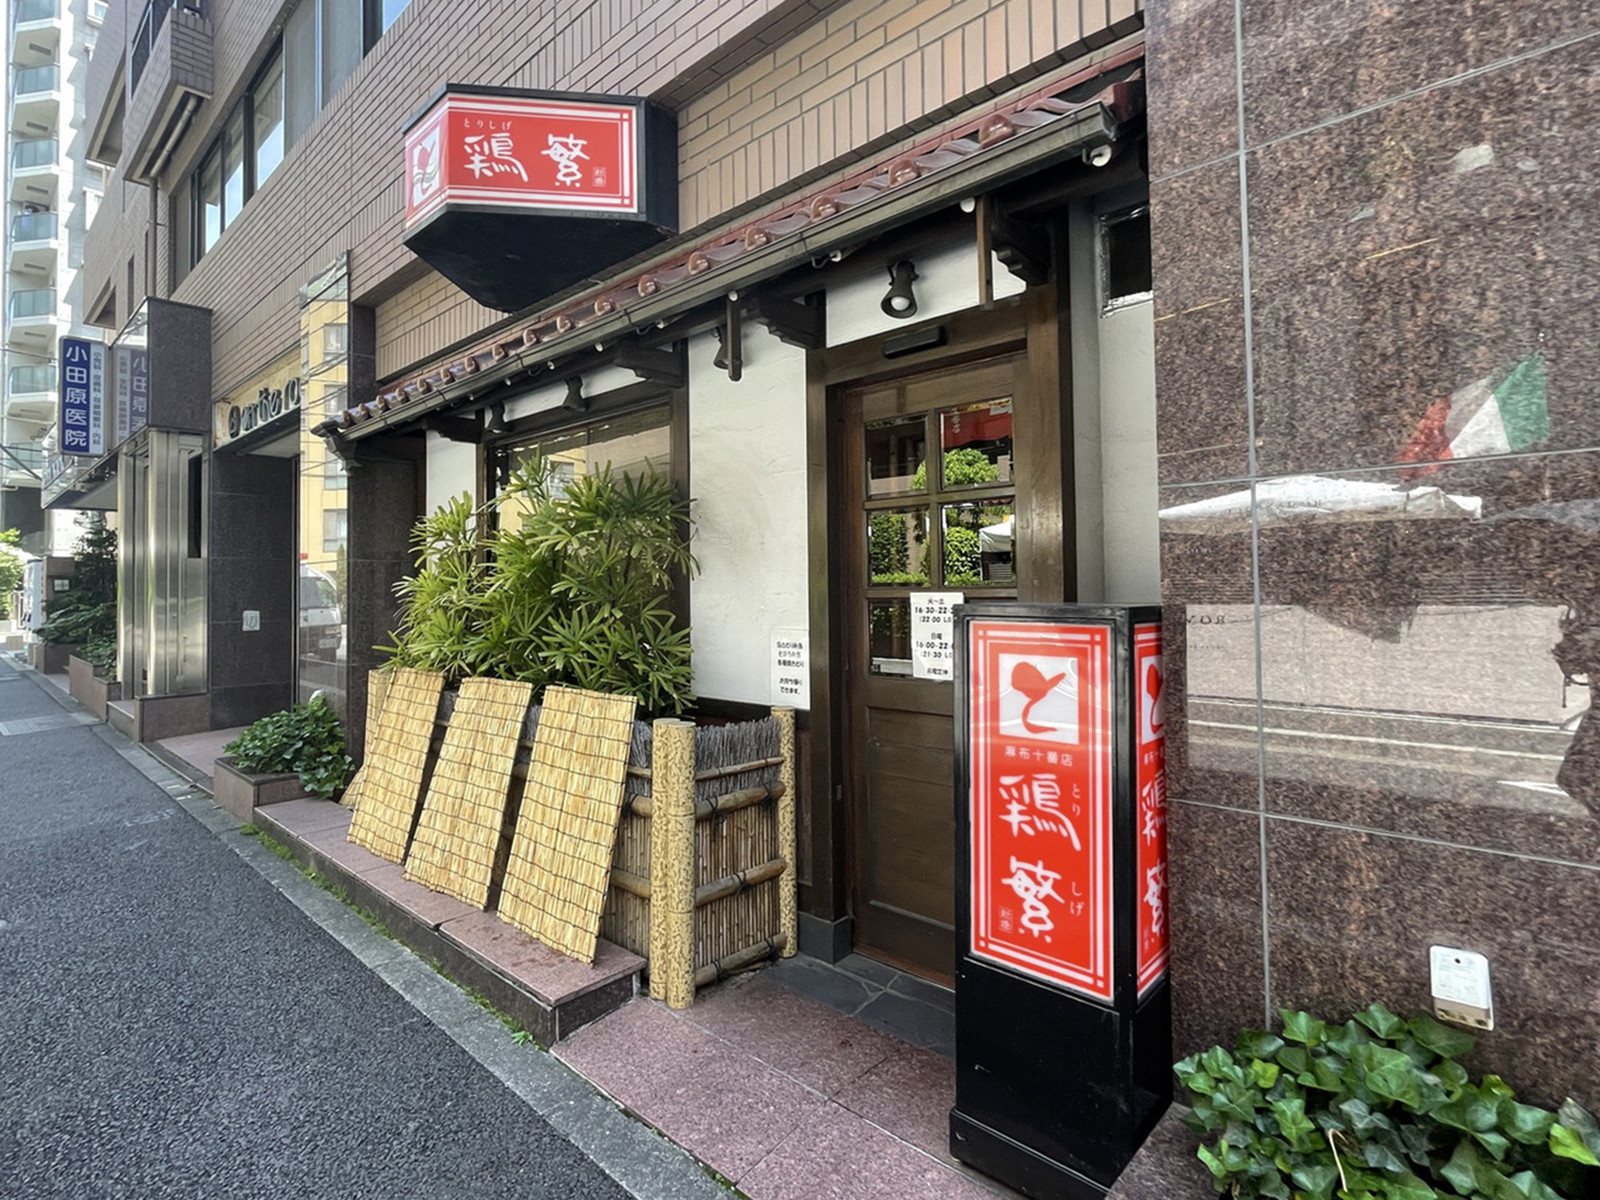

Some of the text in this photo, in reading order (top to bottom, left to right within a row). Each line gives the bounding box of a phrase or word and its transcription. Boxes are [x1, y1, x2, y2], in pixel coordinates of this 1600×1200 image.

[464, 118, 512, 131] とりしげ
[65, 345, 88, 447] 小田原医院
[1005, 745, 1073, 767] 麻布十番店
[1071, 782, 1082, 817] とり
[1069, 880, 1083, 918] しげ
